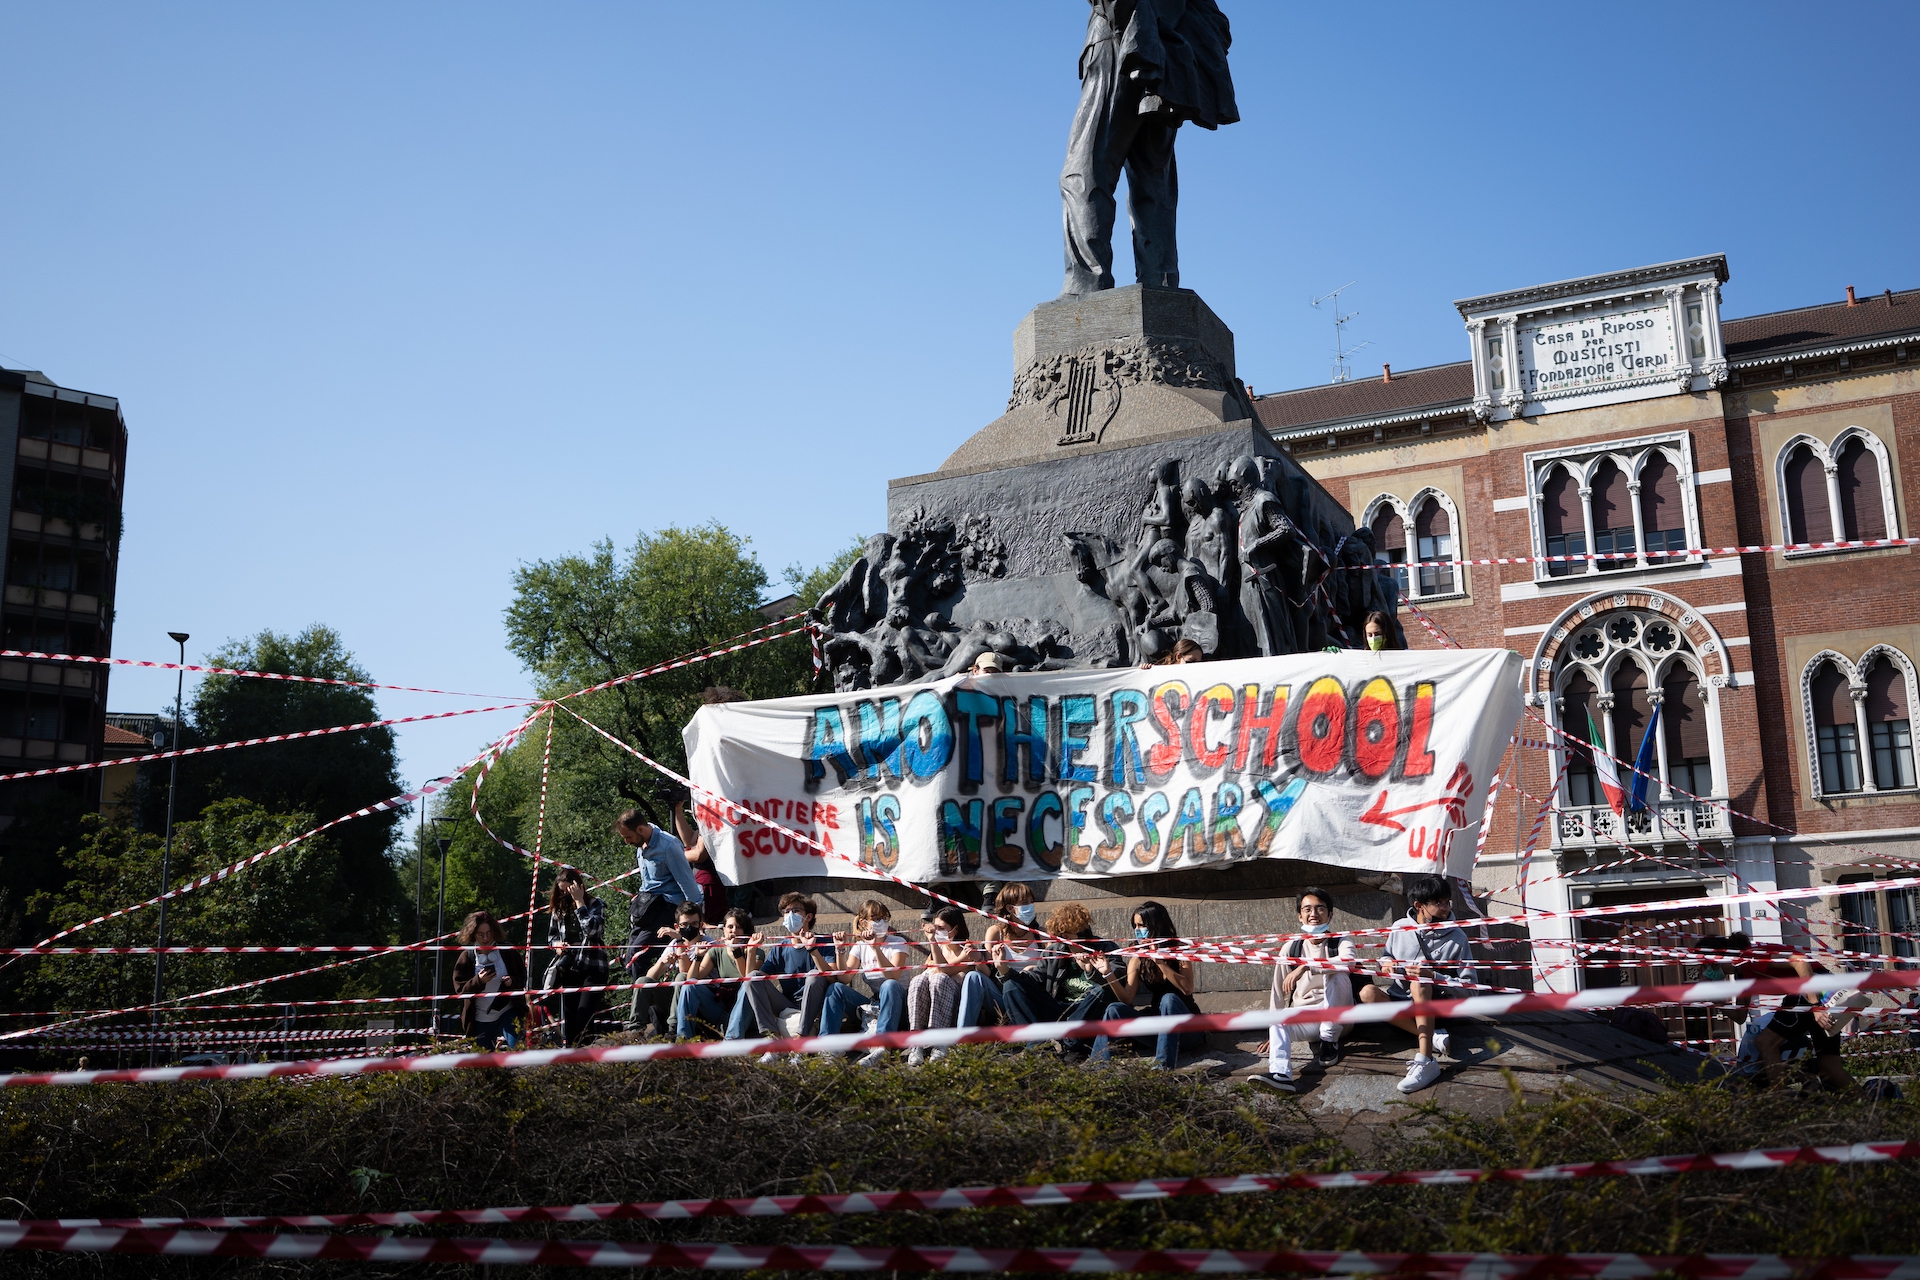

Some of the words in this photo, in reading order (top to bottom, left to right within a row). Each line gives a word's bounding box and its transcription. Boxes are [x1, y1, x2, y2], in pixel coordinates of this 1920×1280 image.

[1535, 332, 1574, 346] CASA
[1581, 328, 1595, 339] DI
[1601, 319, 1655, 336] RIPOSO
[1585, 338, 1605, 347] PER
[1553, 340, 1641, 365] MUSICISTI
[1528, 362, 1615, 386] FONDAZIONE
[1621, 353, 1668, 370] VERDI
[802, 688, 1149, 794] ANOTHER
[1146, 675, 1435, 788] SCHOOL
[855, 794, 901, 872] IS
[937, 777, 1307, 876] NECESSARY
[738, 827, 835, 858] SCUOLA
